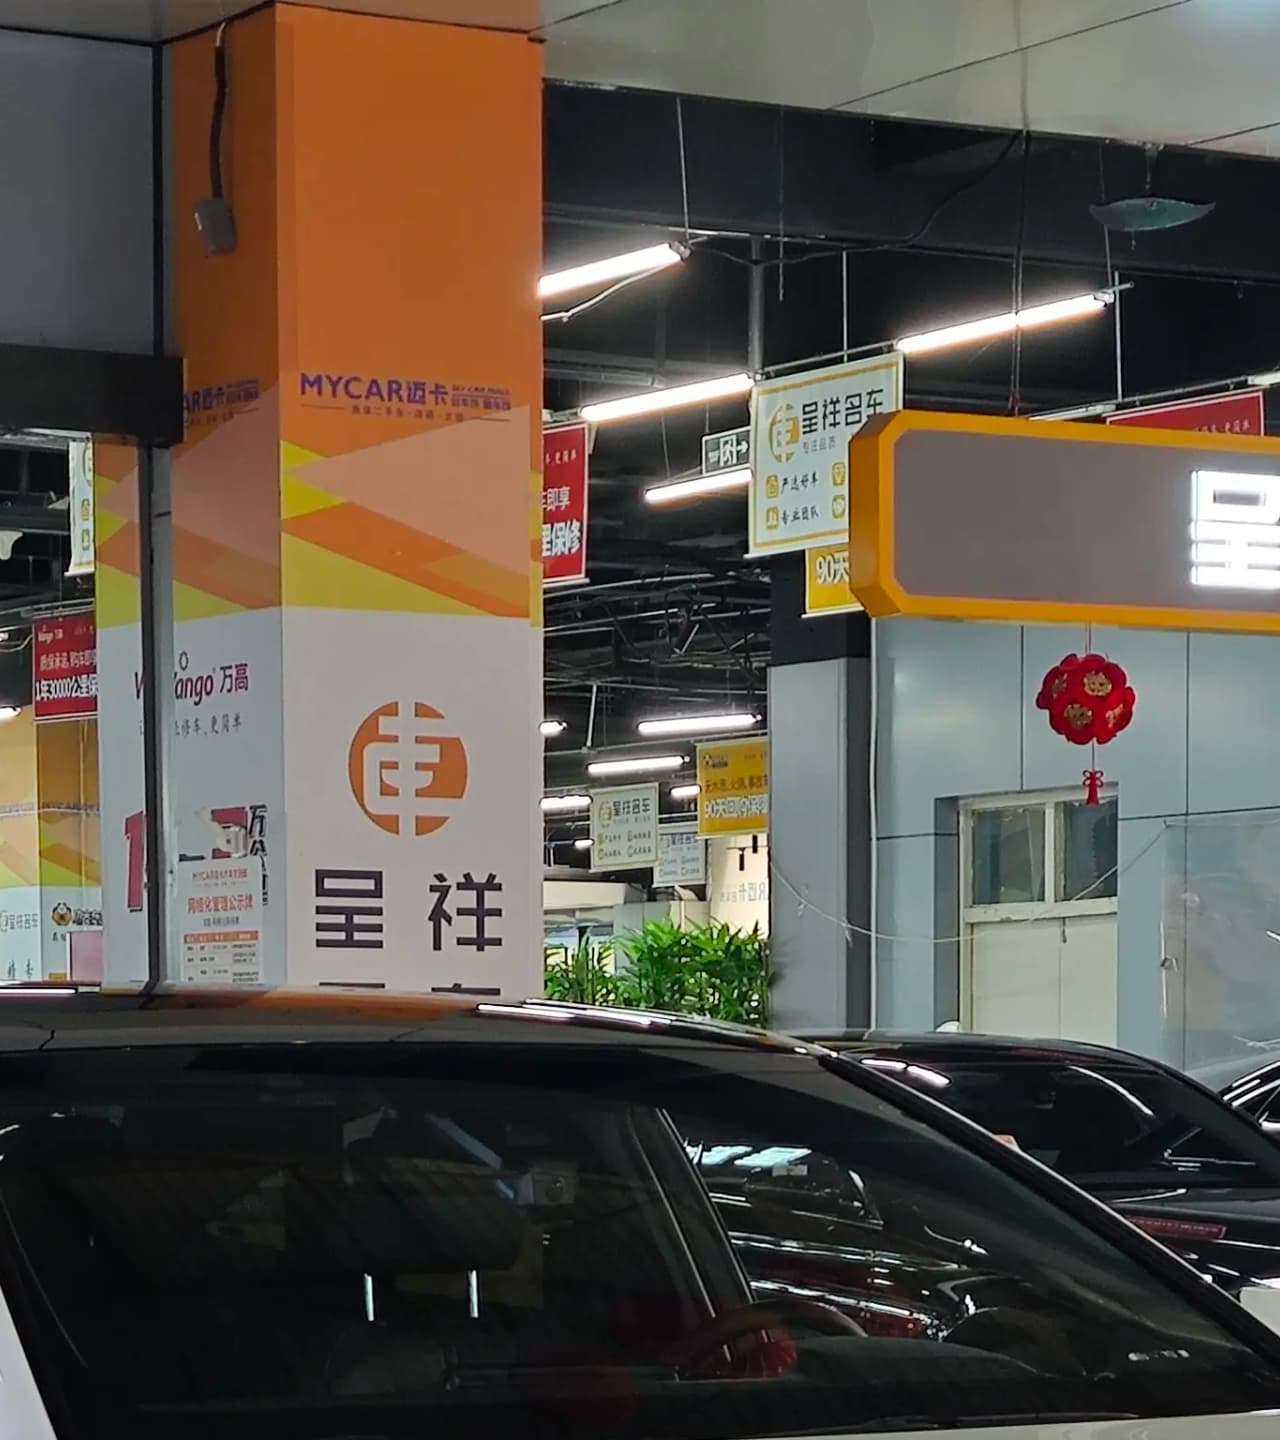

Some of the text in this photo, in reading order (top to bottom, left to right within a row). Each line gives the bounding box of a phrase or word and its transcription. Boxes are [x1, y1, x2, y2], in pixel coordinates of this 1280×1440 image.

[802, 388, 884, 435] 呈祥名车
[220, 664, 248, 694] 万高
